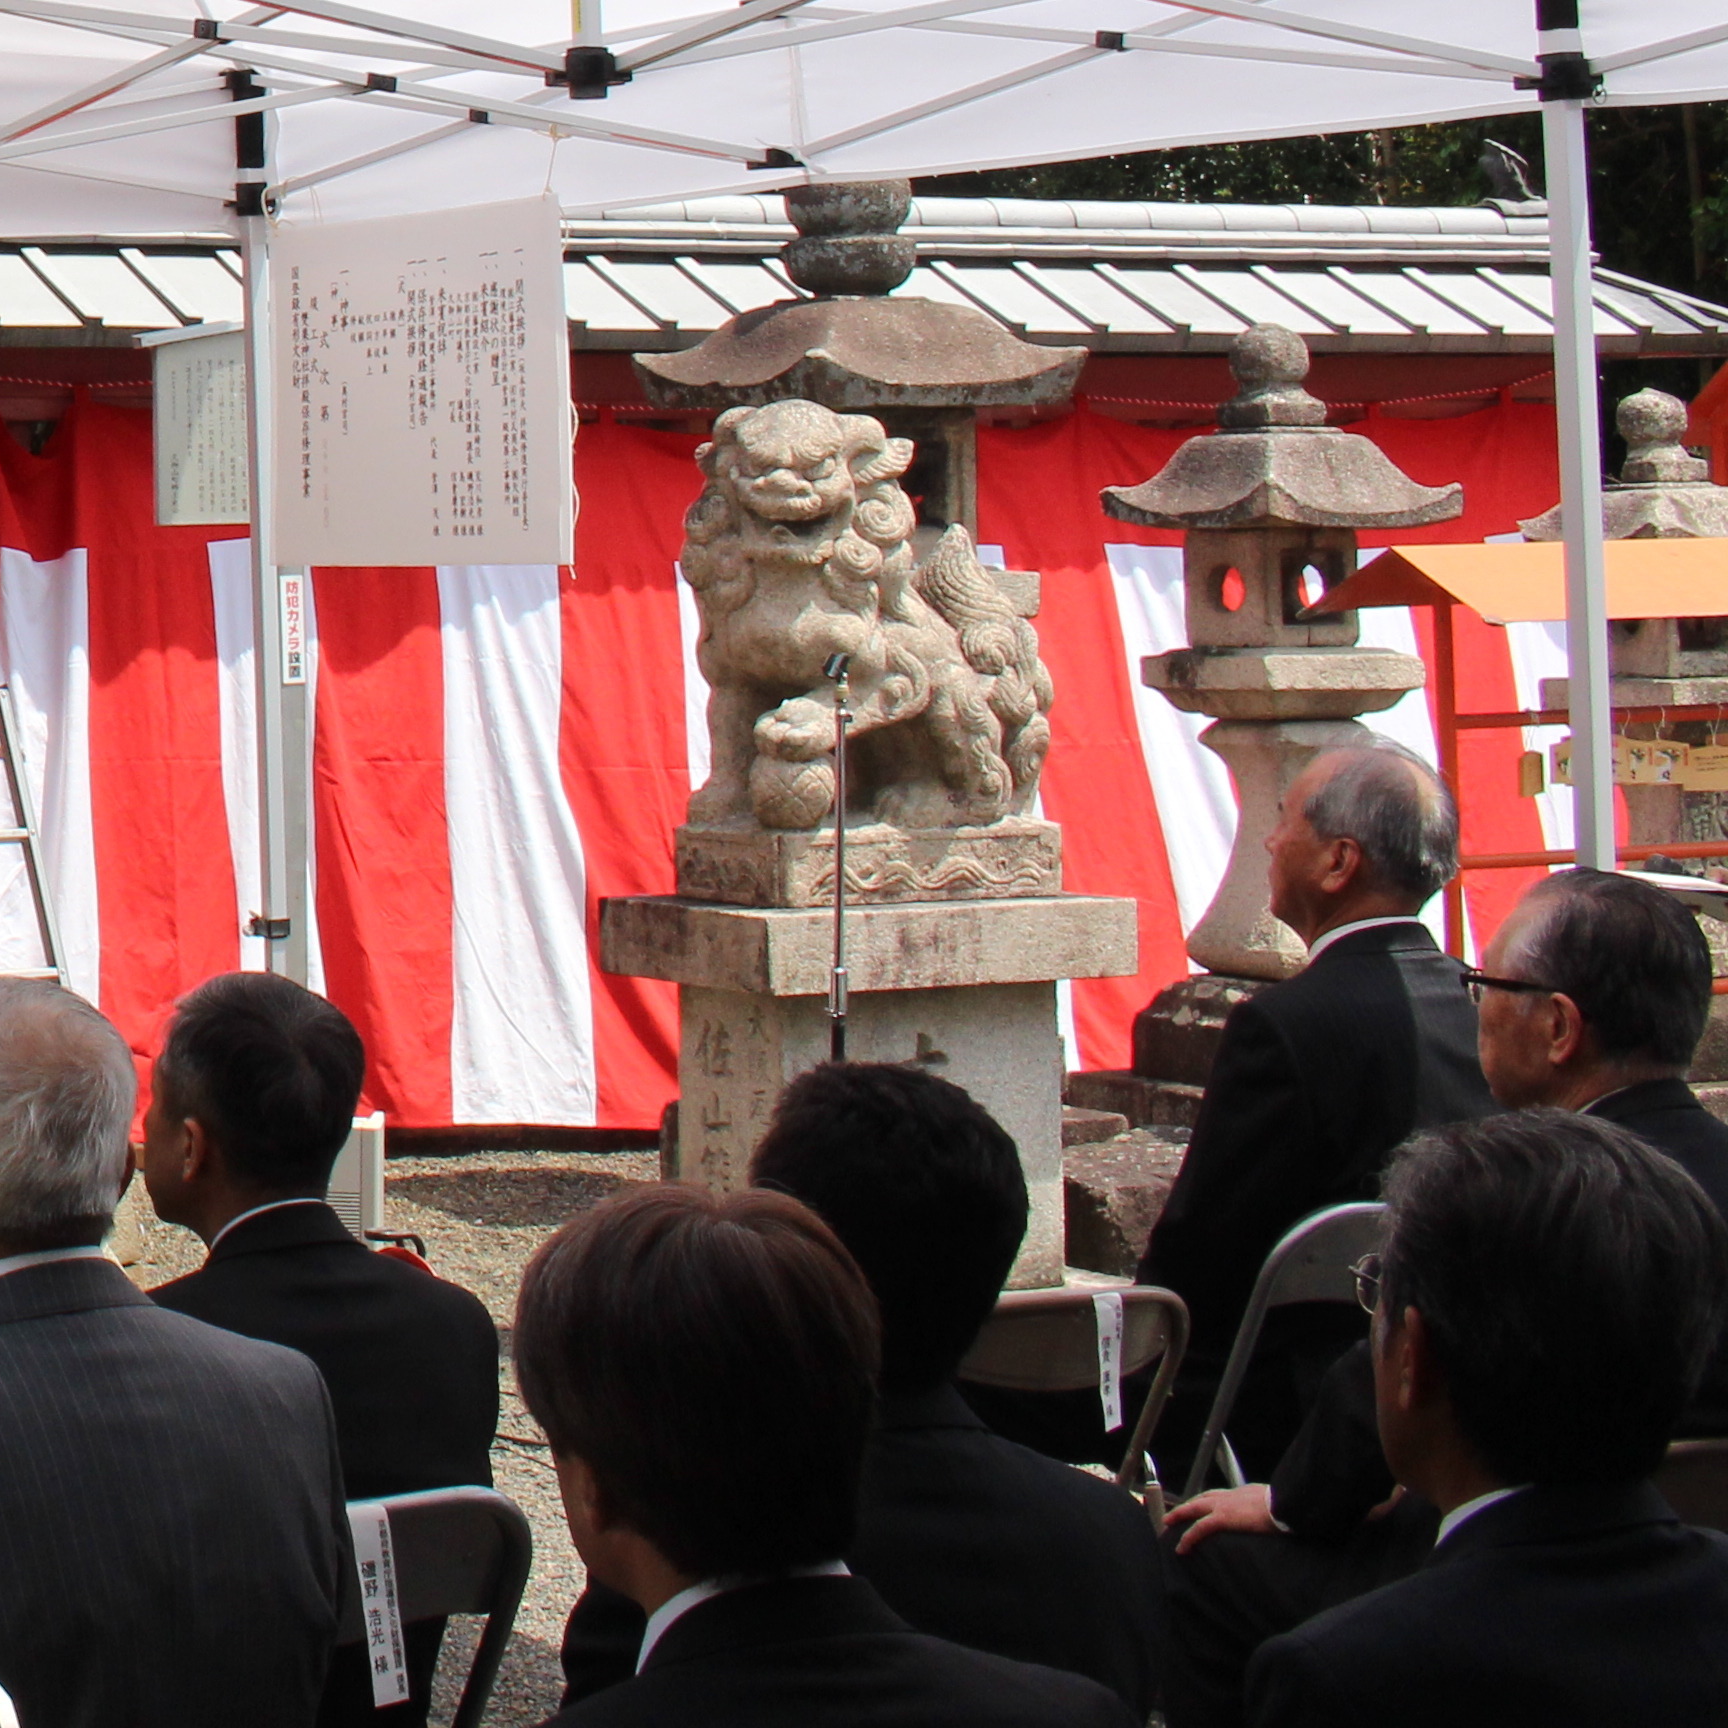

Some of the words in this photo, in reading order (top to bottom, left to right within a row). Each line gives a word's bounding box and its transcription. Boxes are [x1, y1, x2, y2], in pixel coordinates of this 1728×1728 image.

[291, 266, 301, 389] 国登録有形文化財
[318, 331, 330, 422] 式次第
[285, 580, 302, 679] 防犯カメラ設置
[368, 1608, 385, 1646] 浩光
[374, 1656, 389, 1674] 様
